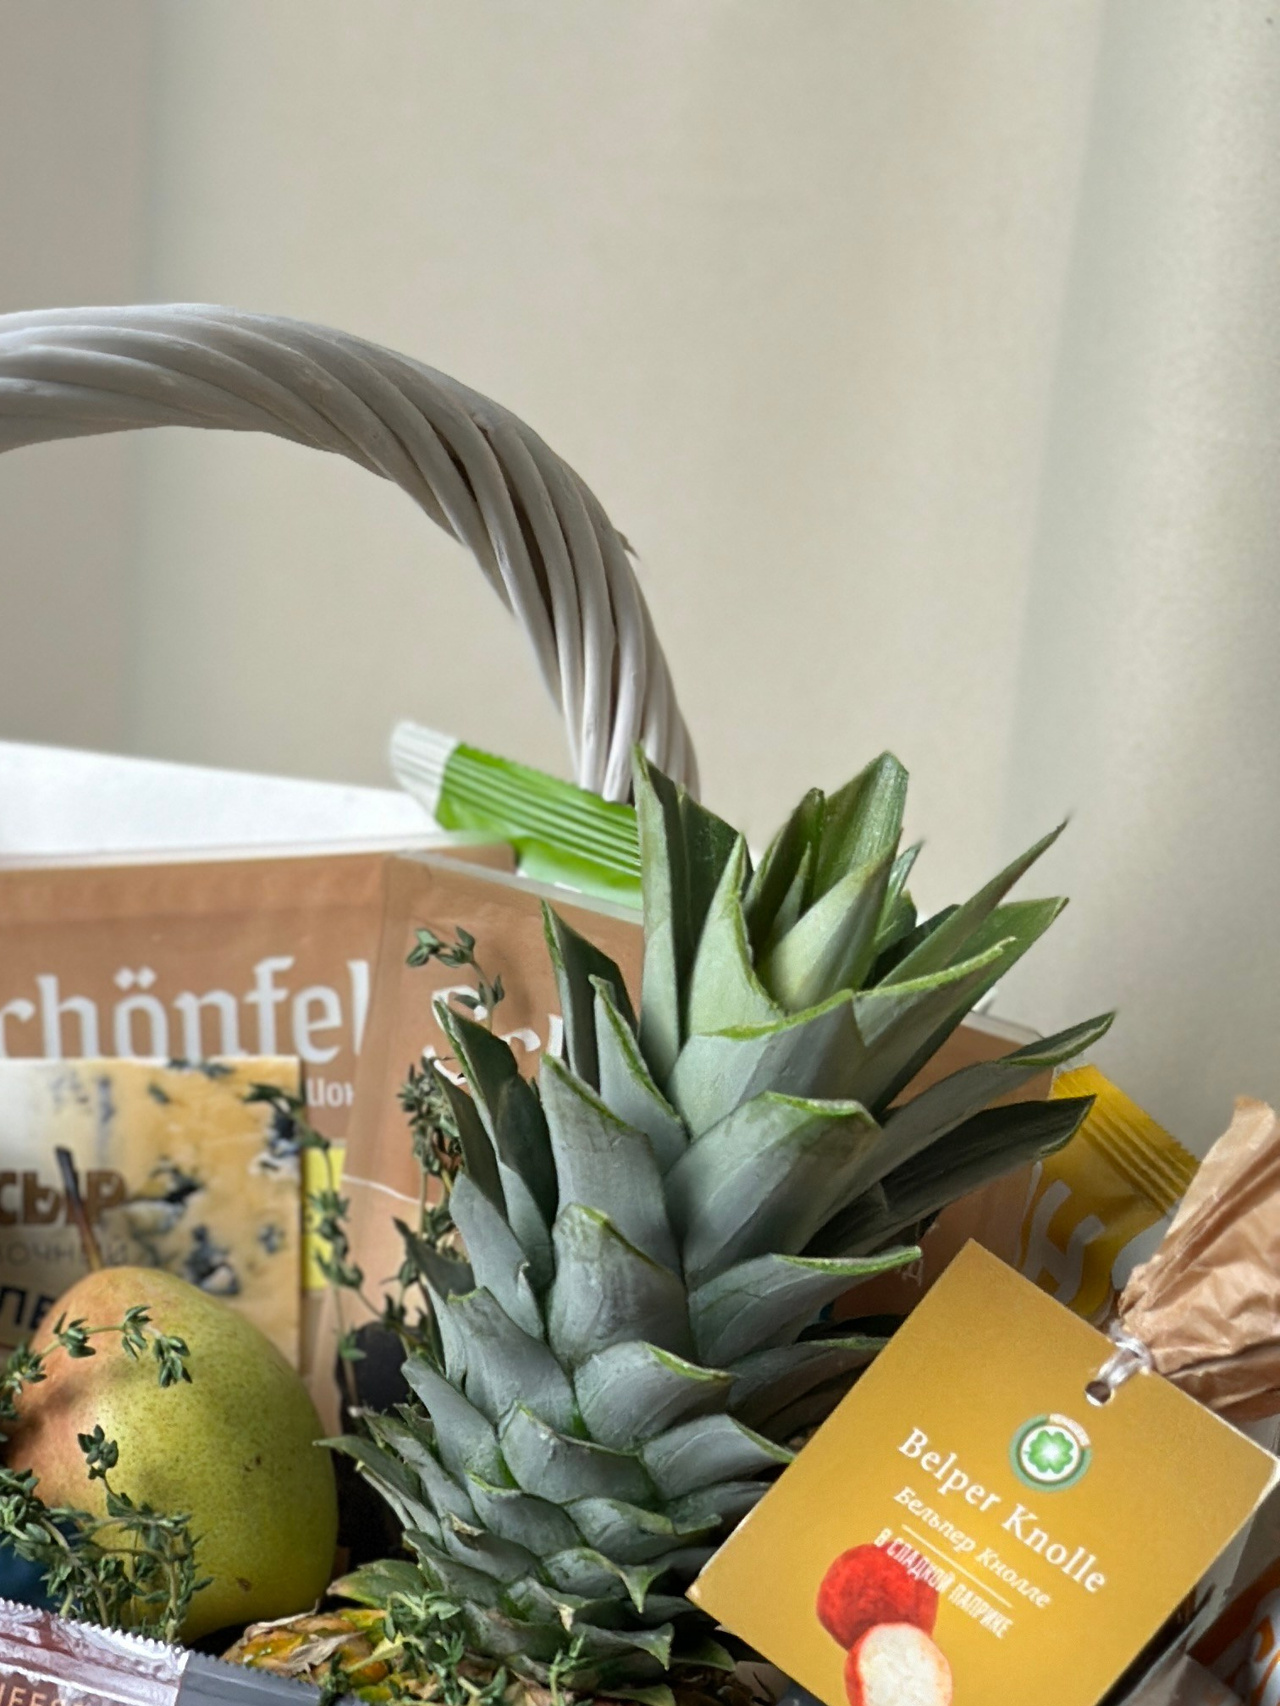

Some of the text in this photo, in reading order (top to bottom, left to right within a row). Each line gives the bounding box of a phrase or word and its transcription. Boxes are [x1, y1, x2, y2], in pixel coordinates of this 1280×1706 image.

[893, 1485, 1053, 1610] Бельпер Кнолле
[897, 1426, 1107, 1594] Belper Knolle
[886, 1536, 956, 1594] СЛАДКОЙ
[947, 1583, 1014, 1640] ПАПРИКЕ
